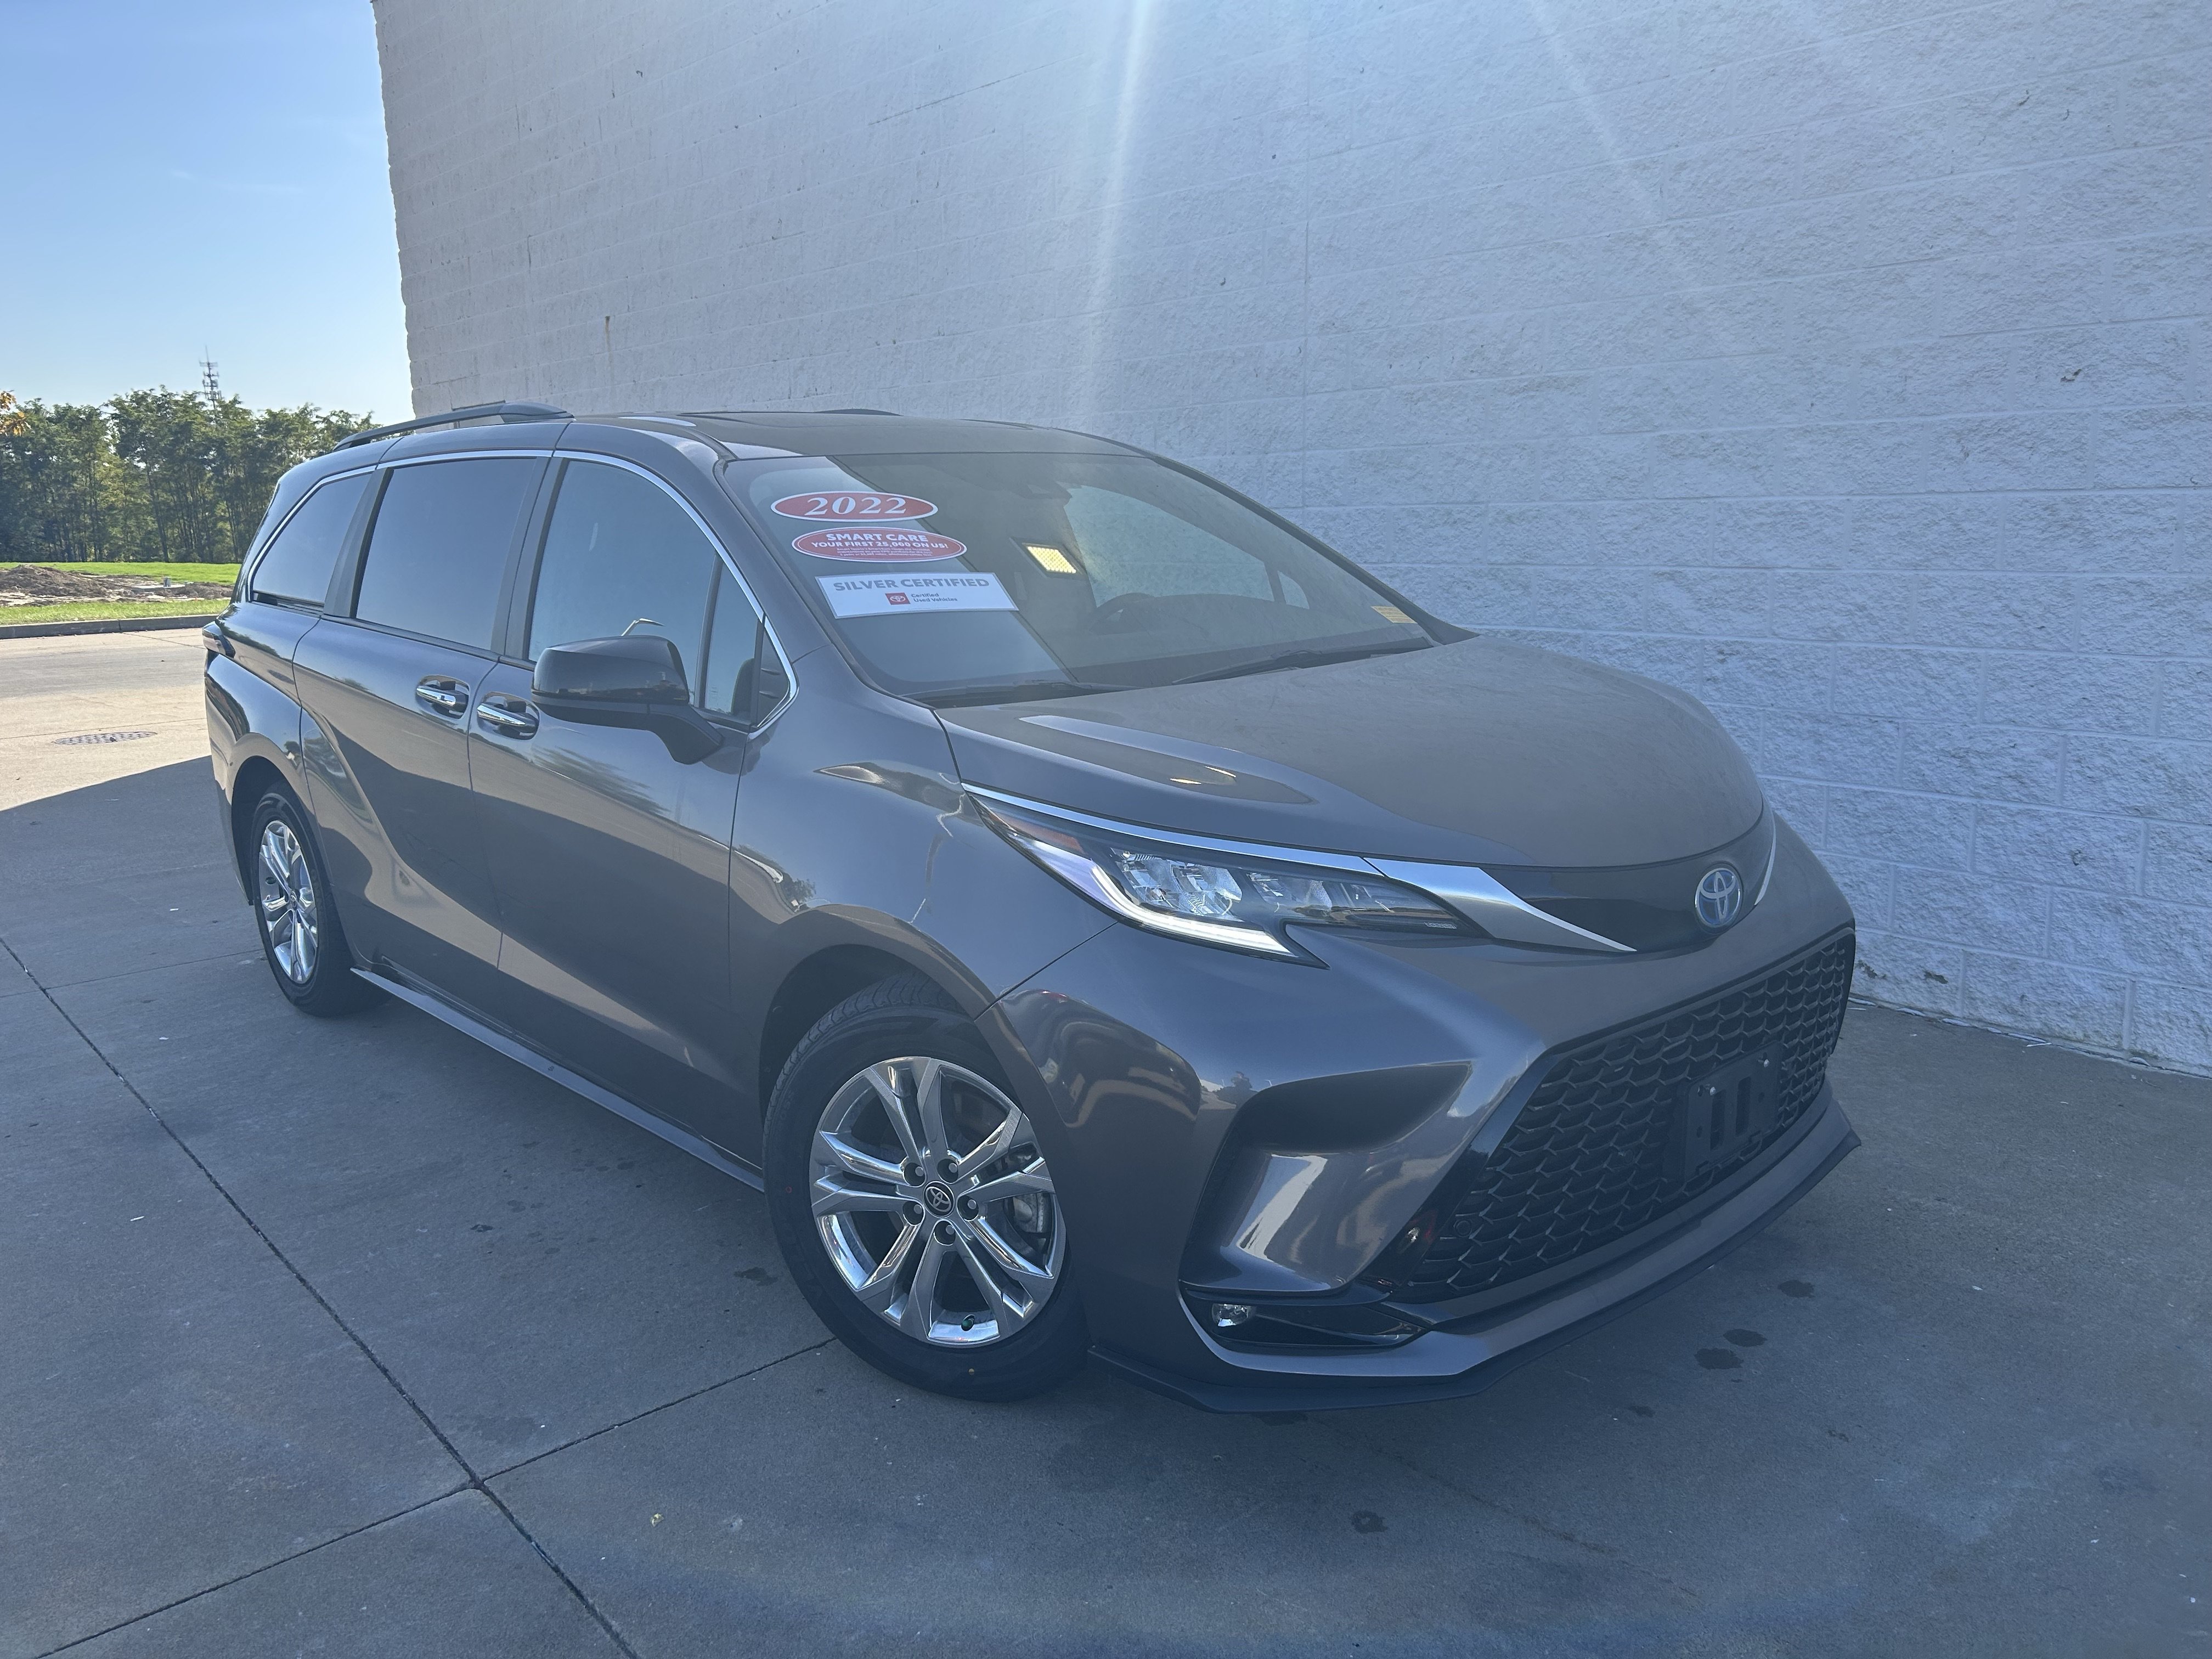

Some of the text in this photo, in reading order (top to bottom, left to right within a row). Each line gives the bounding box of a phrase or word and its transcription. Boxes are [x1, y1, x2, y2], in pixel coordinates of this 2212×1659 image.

[804, 496, 906, 516] 2022
[886, 534, 928, 542] CARE
[833, 578, 989, 591] SILVER CERTIFIED
